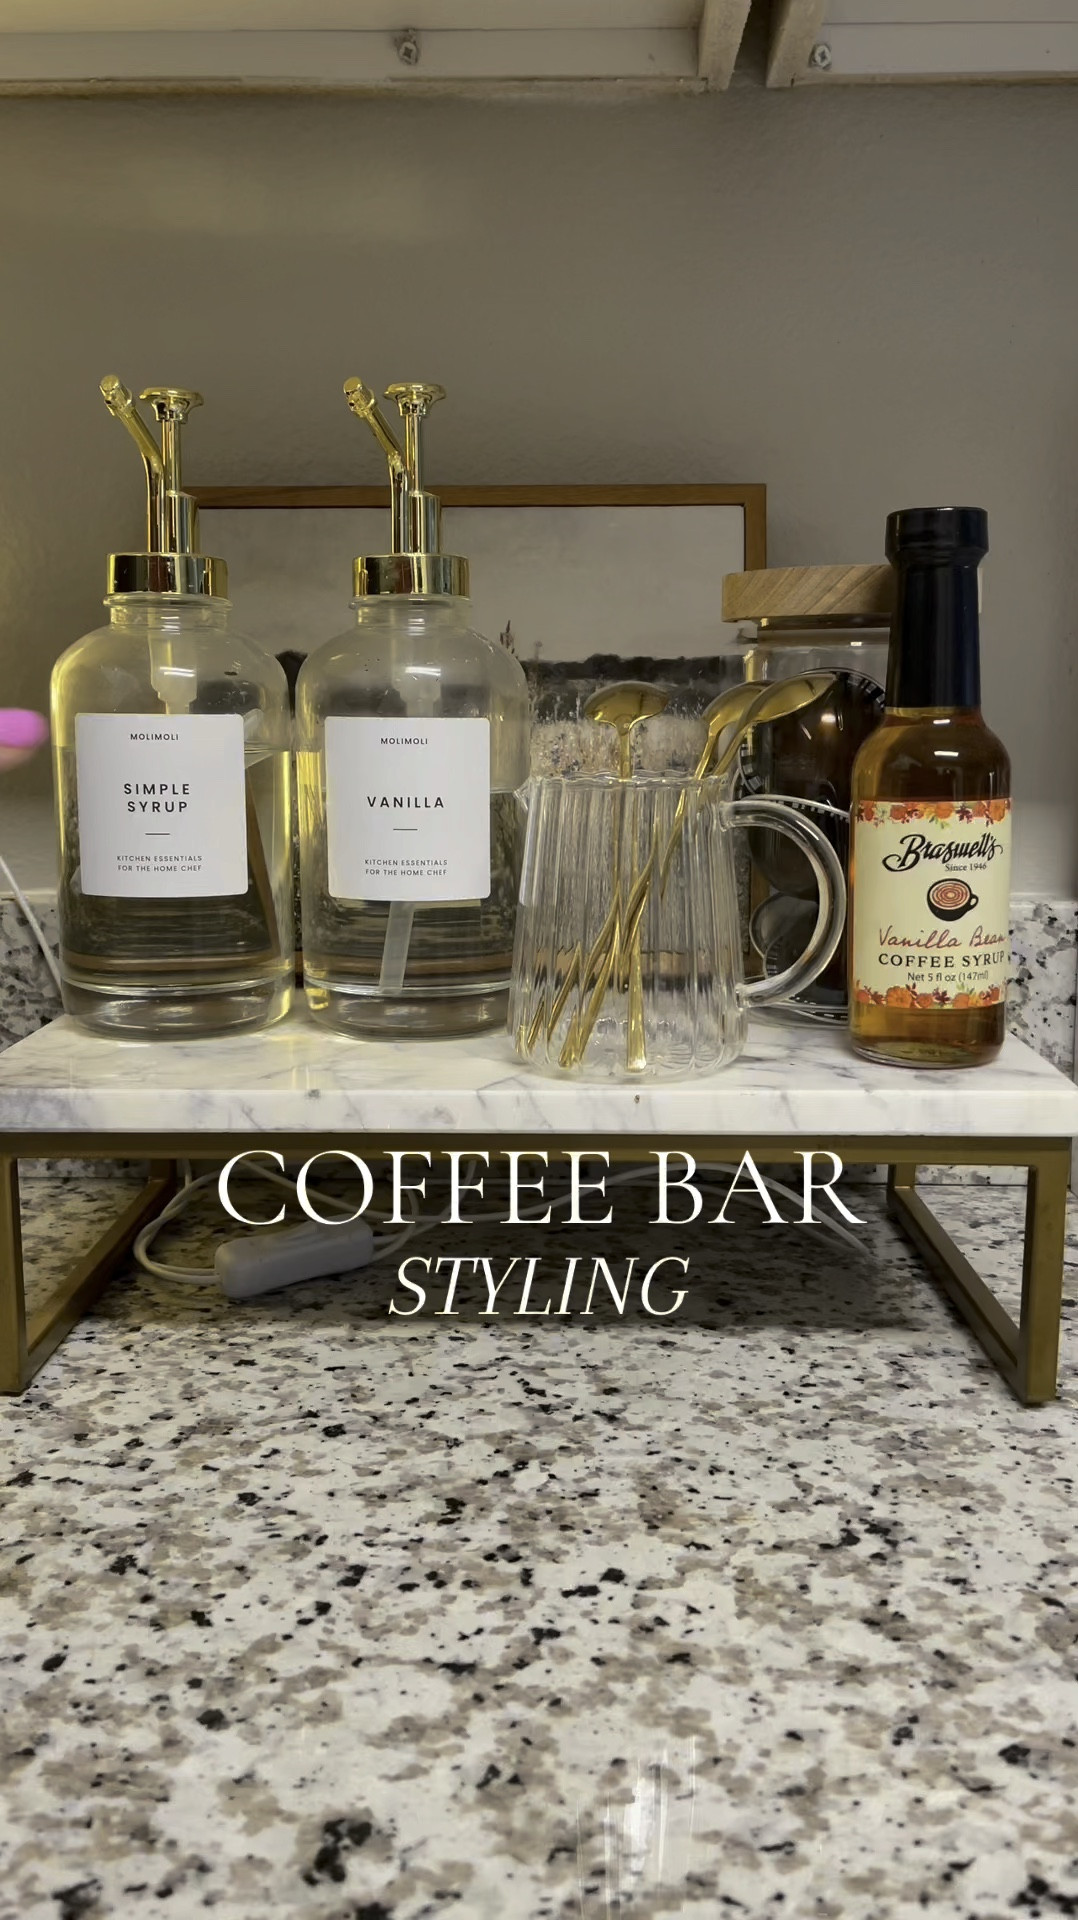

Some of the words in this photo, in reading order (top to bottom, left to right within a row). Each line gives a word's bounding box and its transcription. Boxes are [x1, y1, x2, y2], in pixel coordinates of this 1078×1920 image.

[130, 733, 179, 741] MOLIMOLI
[380, 737, 428, 745] MOLIMOLI
[123, 783, 191, 795] SIMPLE
[127, 801, 188, 813] SYRUP
[367, 796, 445, 809] VANILLA
[882, 832, 1004, 872] Braswell's
[945, 863, 967, 872] Since
[969, 862, 987, 871] 1946
[879, 925, 962, 949] Vanilla
[969, 925, 1007, 948] Bean
[878, 953, 955, 968] COFFEE
[962, 950, 1005, 967] SYRUP
[907, 972, 925, 982] Net
[927, 972, 934, 982] 5
[936, 971, 942, 982] fl
[944, 974, 956, 982] oz
[958, 970, 989, 983] (147ml)
